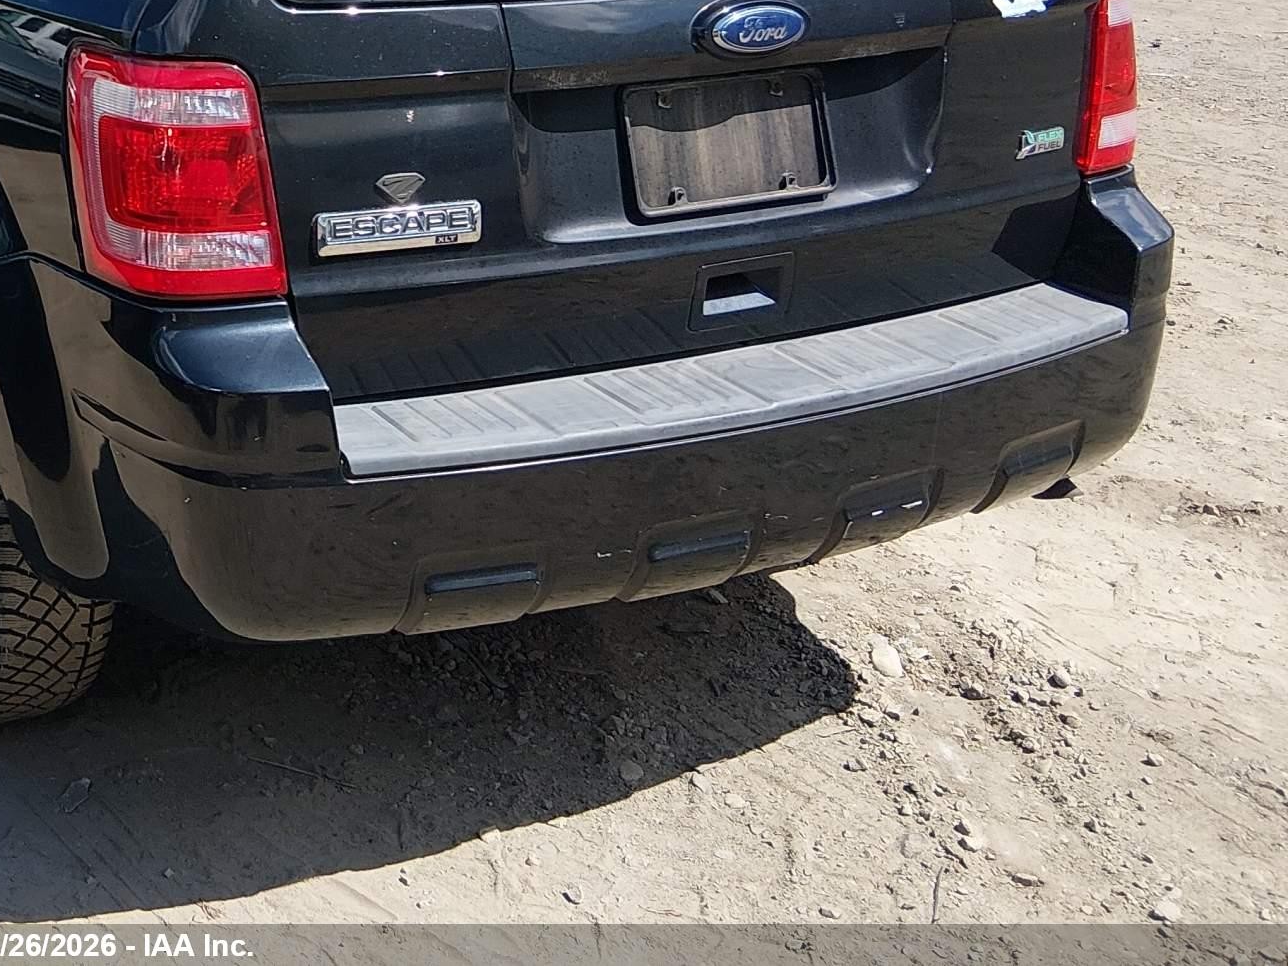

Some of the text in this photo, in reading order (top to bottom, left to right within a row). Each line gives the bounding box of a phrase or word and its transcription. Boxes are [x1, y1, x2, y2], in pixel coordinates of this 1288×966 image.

[739, 15, 788, 43] Ford
[330, 207, 471, 239] ESCAPE
[437, 235, 457, 243] XLT
